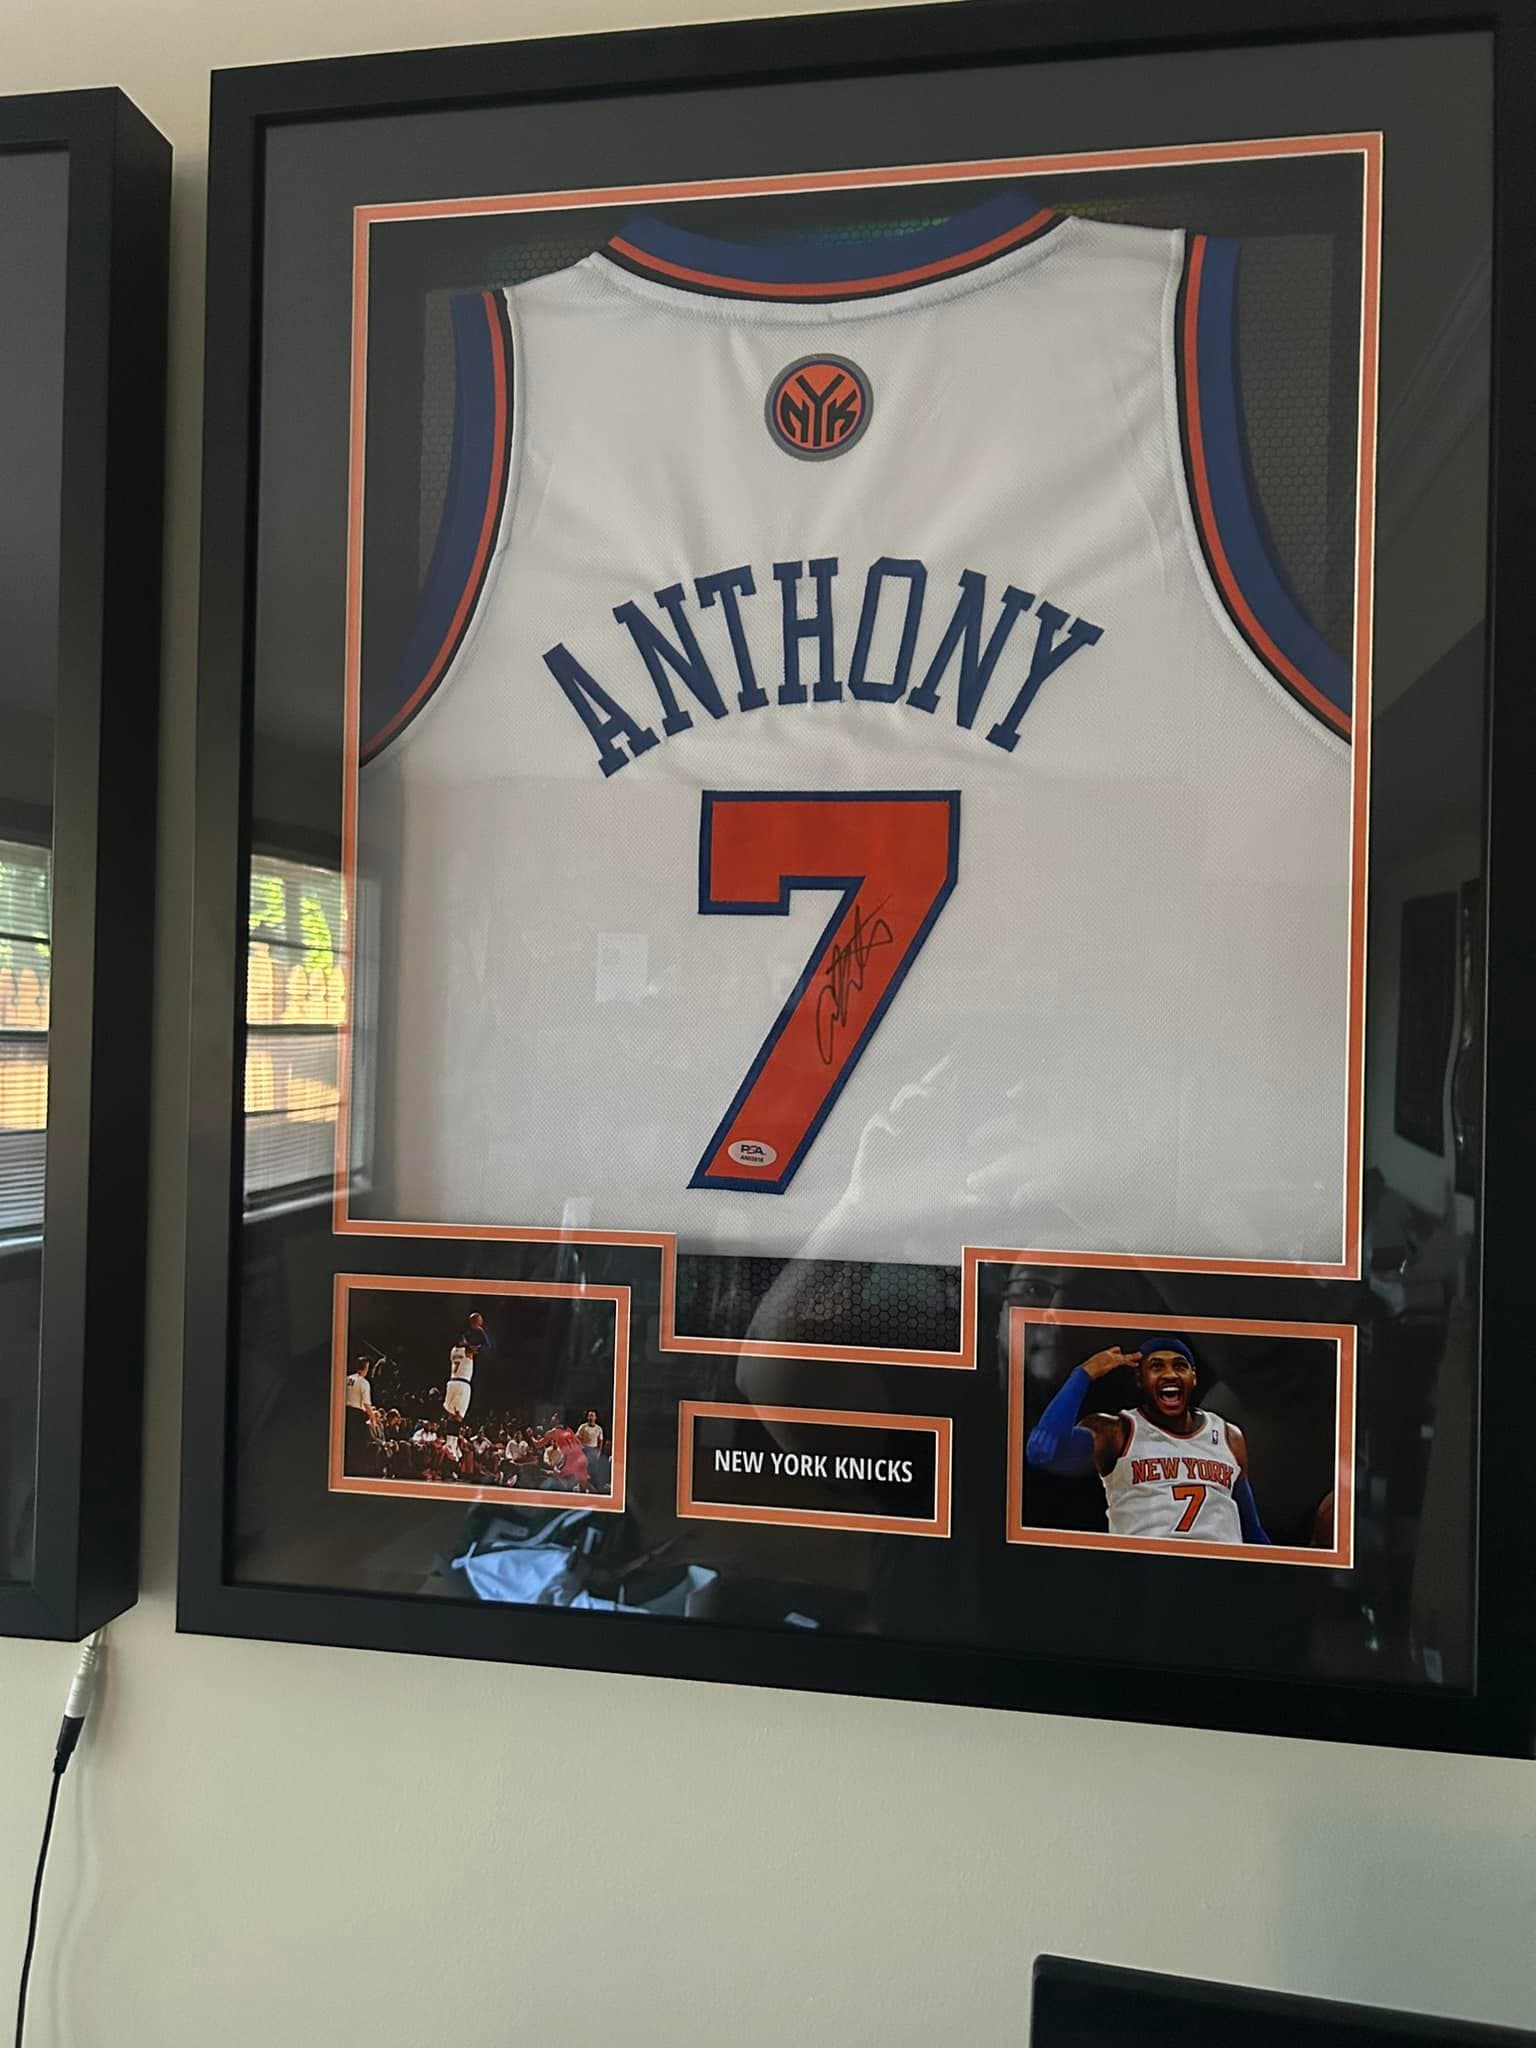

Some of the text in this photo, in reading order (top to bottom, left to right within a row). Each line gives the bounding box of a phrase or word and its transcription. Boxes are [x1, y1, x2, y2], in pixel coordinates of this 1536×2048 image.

[781, 372, 858, 447] NYK
[542, 556, 1104, 778] ANTHONY
[687, 790, 962, 1195] 7
[741, 1144, 766, 1155] PSA
[715, 1449, 913, 1483] NEW YORK KNICKS
[1131, 1457, 1233, 1490] NEW YORK
[1171, 1484, 1207, 1532] 7
